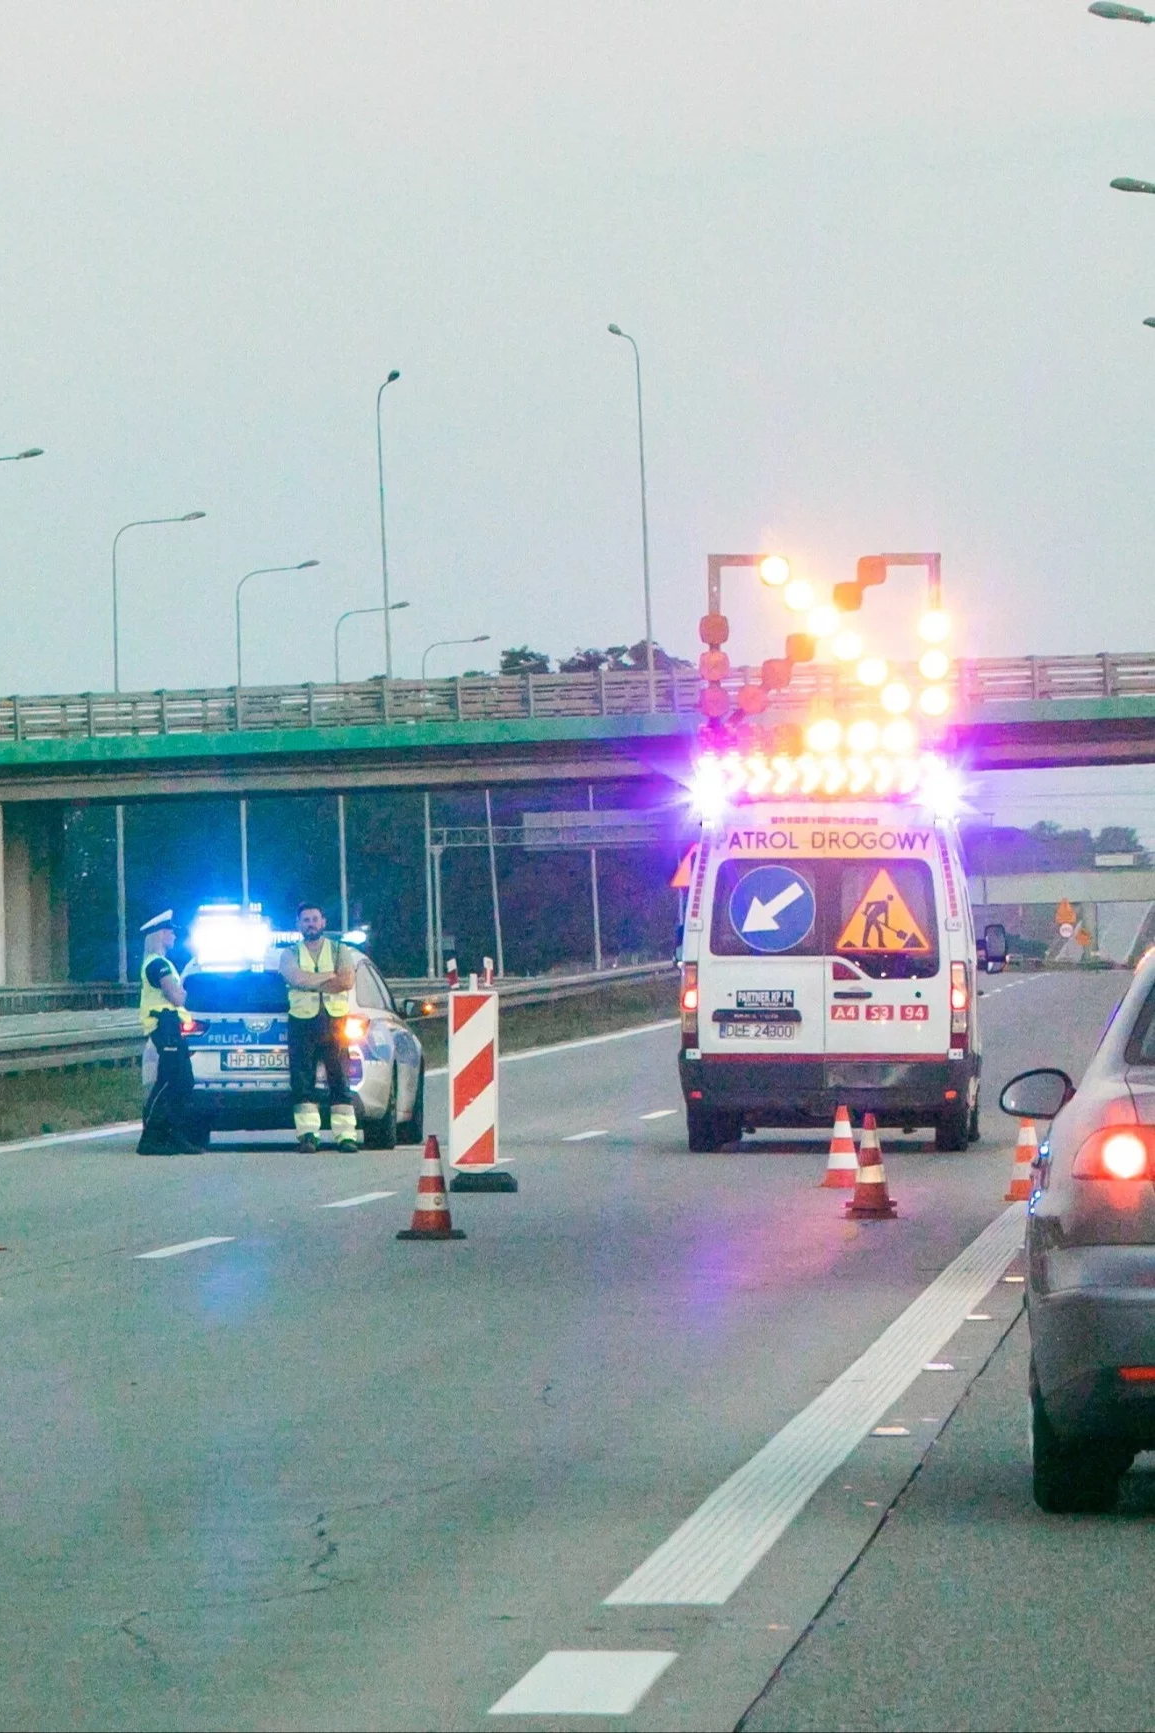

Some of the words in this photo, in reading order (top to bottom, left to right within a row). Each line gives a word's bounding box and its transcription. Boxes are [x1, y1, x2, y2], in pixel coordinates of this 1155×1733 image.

[811, 831, 930, 850] DROGOWY
[834, 1006, 856, 1019] A4
[870, 1006, 889, 1019] S3
[907, 1006, 925, 1019] 94
[208, 1034, 252, 1043] POLICJA
[230, 1054, 254, 1066] HPB
